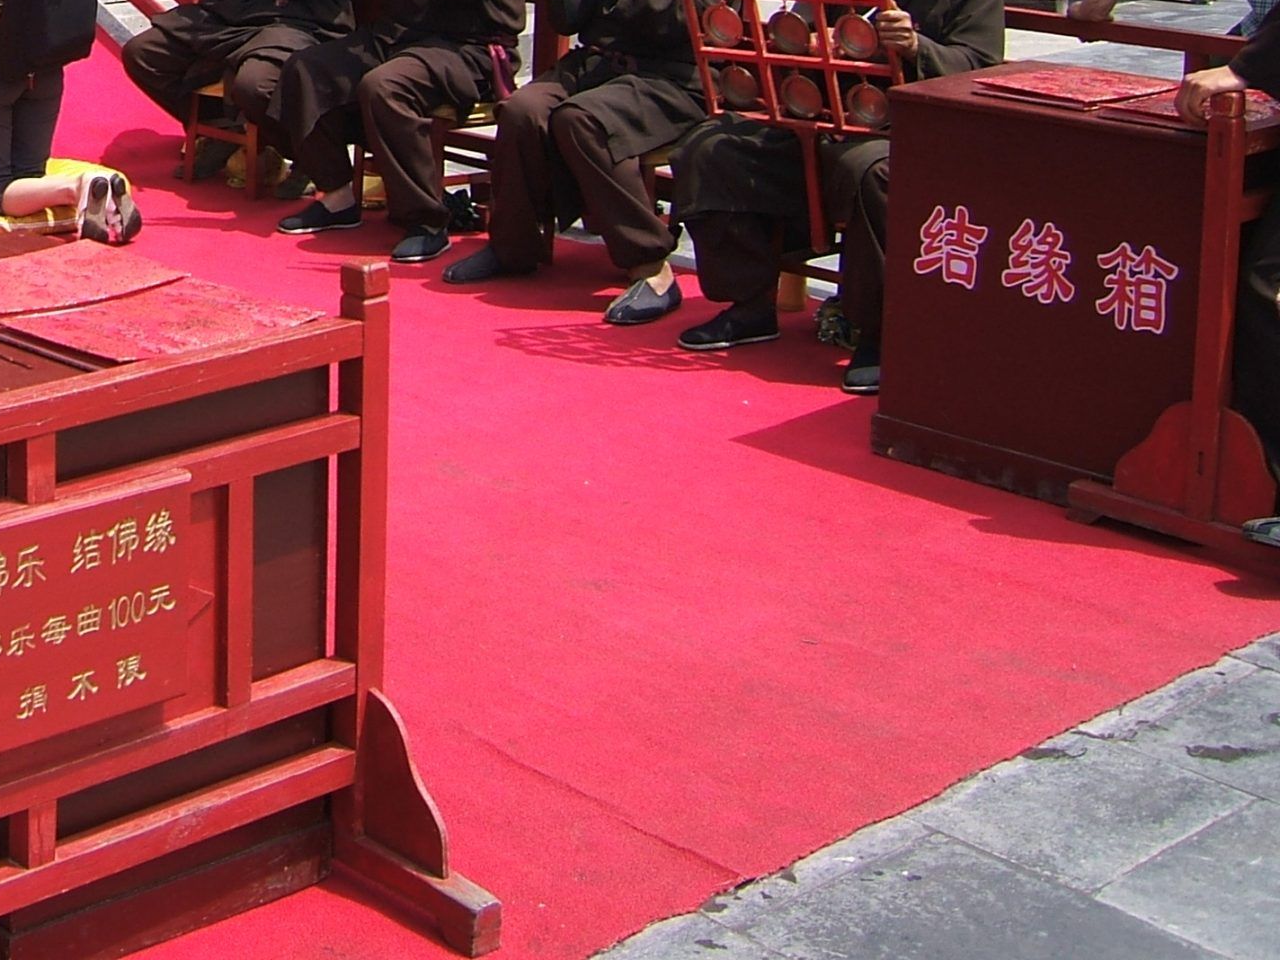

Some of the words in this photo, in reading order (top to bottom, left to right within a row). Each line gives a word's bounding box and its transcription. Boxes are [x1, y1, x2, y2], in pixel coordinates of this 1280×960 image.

[914, 205, 1179, 334] 结缘箱
[70, 506, 177, 574] 结佛缘
